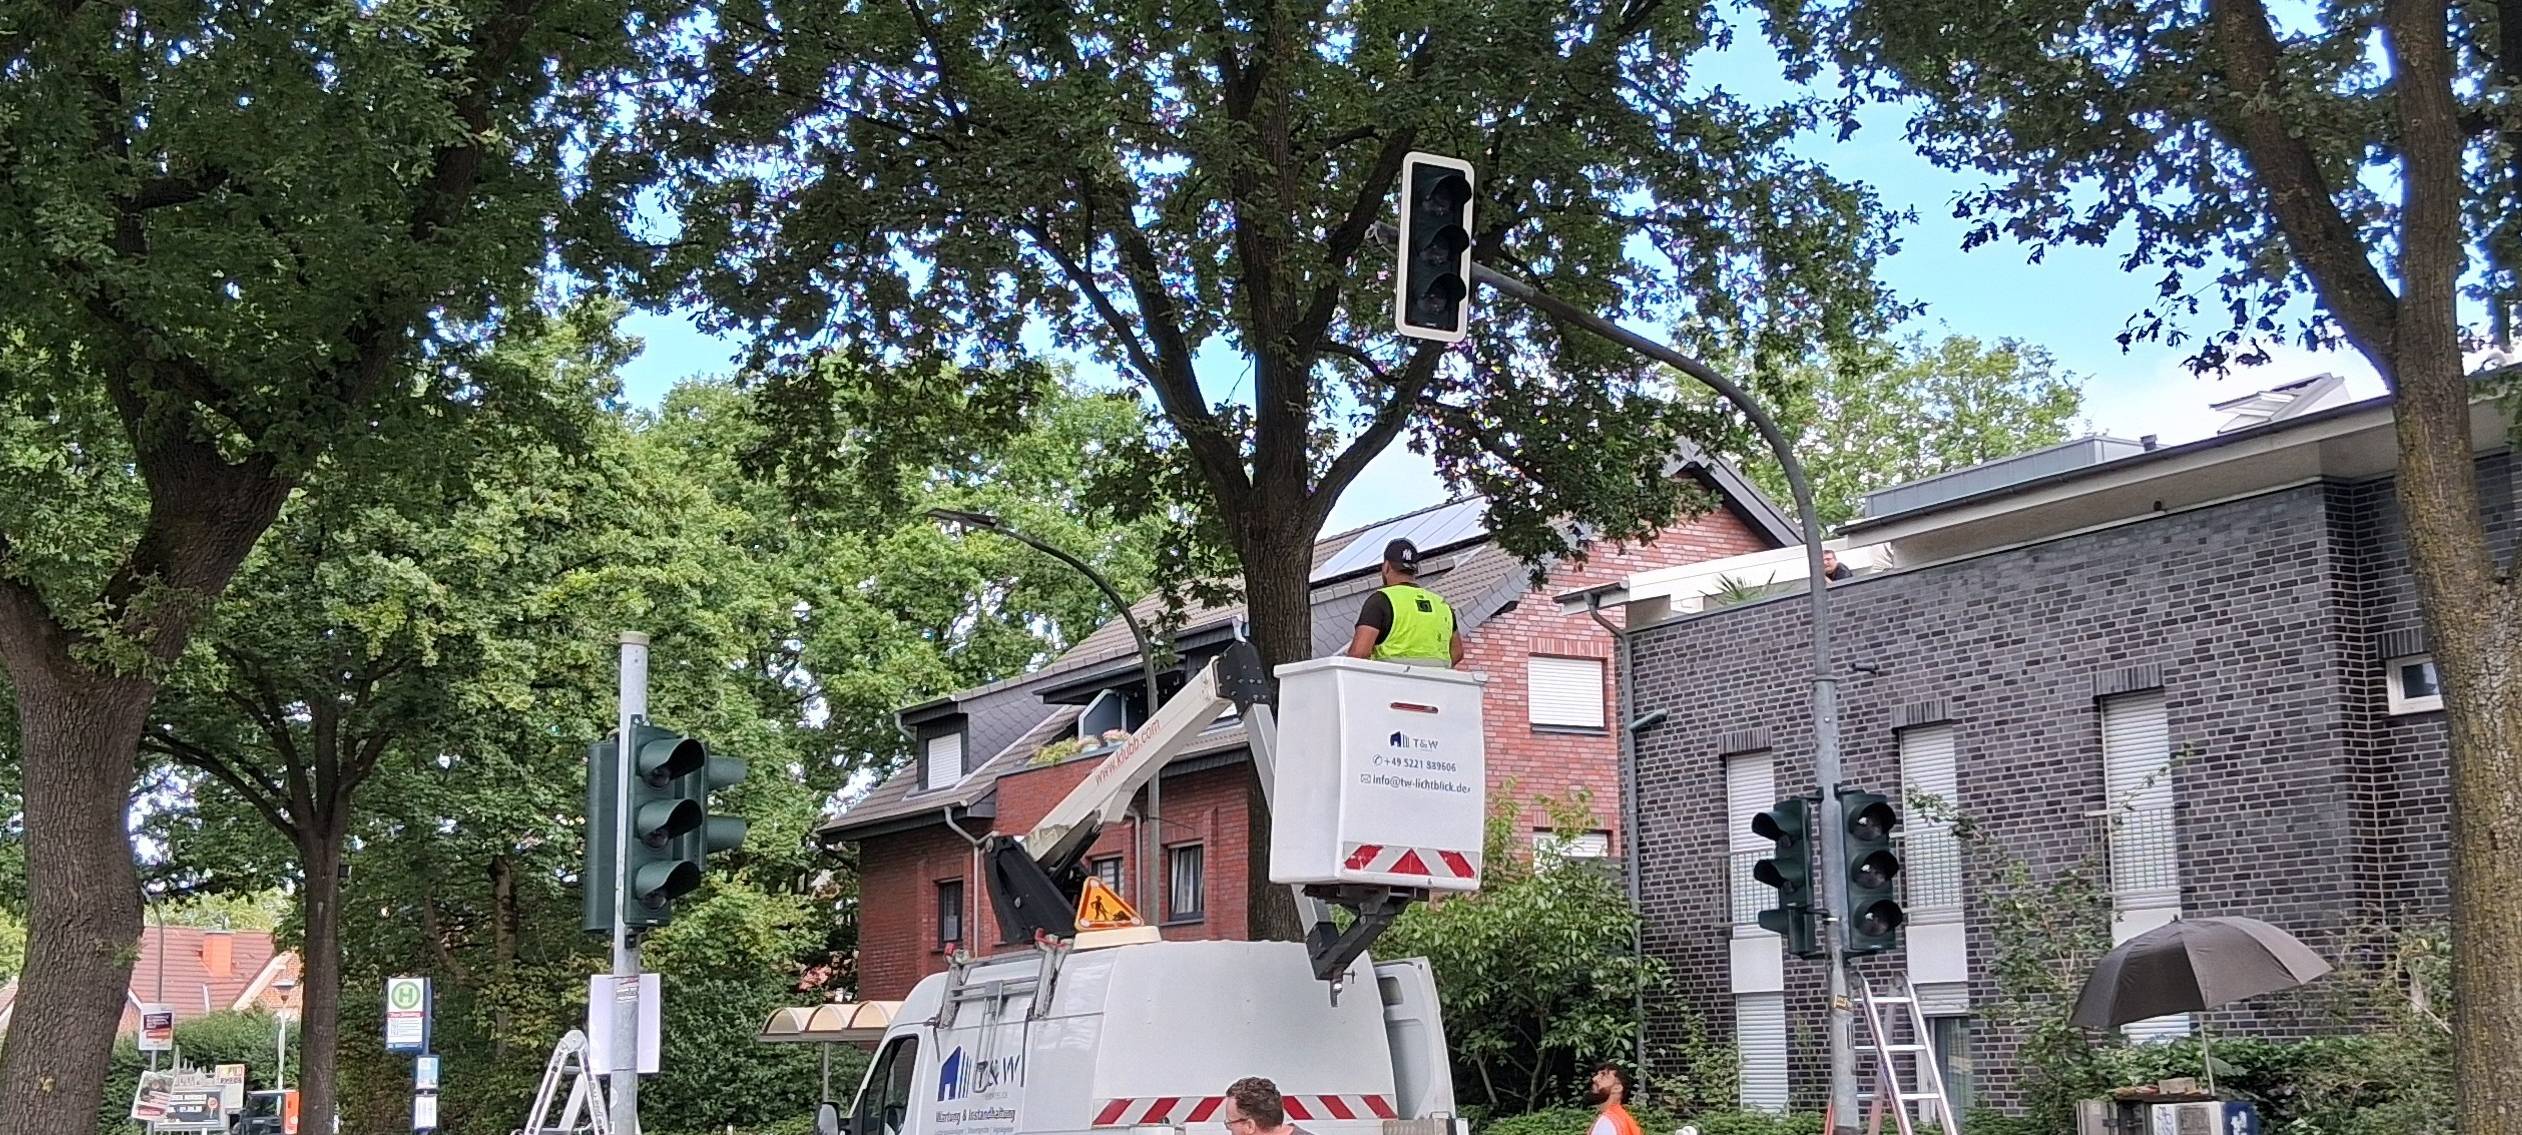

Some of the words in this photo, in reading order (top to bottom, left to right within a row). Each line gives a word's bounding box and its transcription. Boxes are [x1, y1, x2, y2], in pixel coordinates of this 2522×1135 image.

[1413, 738, 1438, 750] T&W
[1384, 757, 1401, 767] +49
[1403, 758, 1423, 769] 5221
[399, 988, 413, 1003] H
